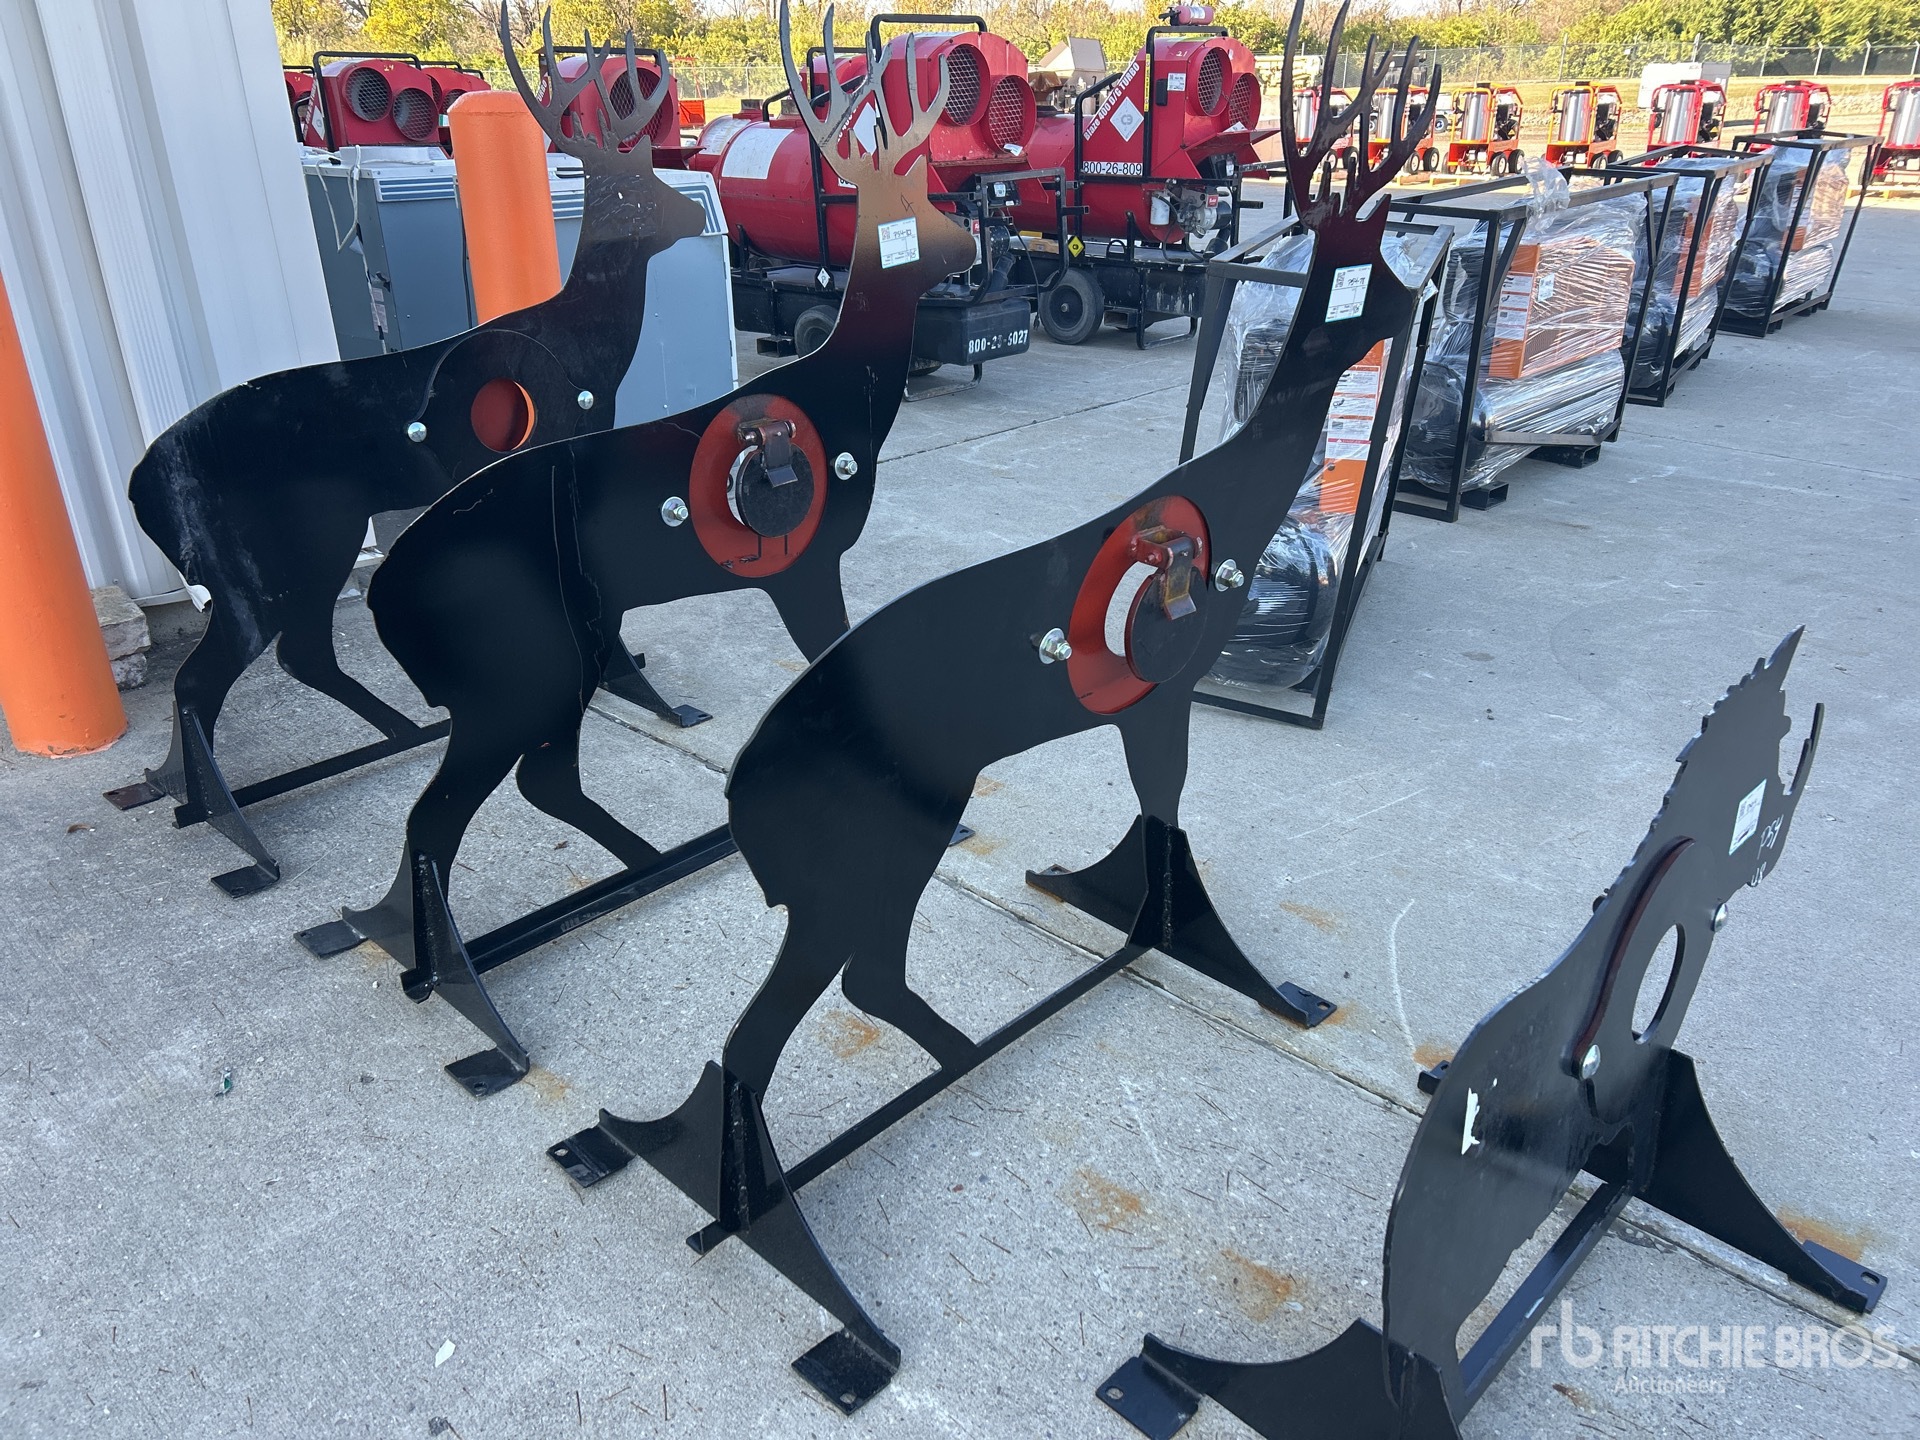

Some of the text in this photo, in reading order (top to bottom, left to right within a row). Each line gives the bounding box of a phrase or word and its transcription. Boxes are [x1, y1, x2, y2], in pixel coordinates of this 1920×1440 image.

[537, 79, 548, 102] URBO
[1083, 118, 1101, 141] Blaze
[1098, 104, 1112, 120] 400
[1118, 62, 1140, 91] TURBO
[1083, 162, 1142, 176] 800-26-809
